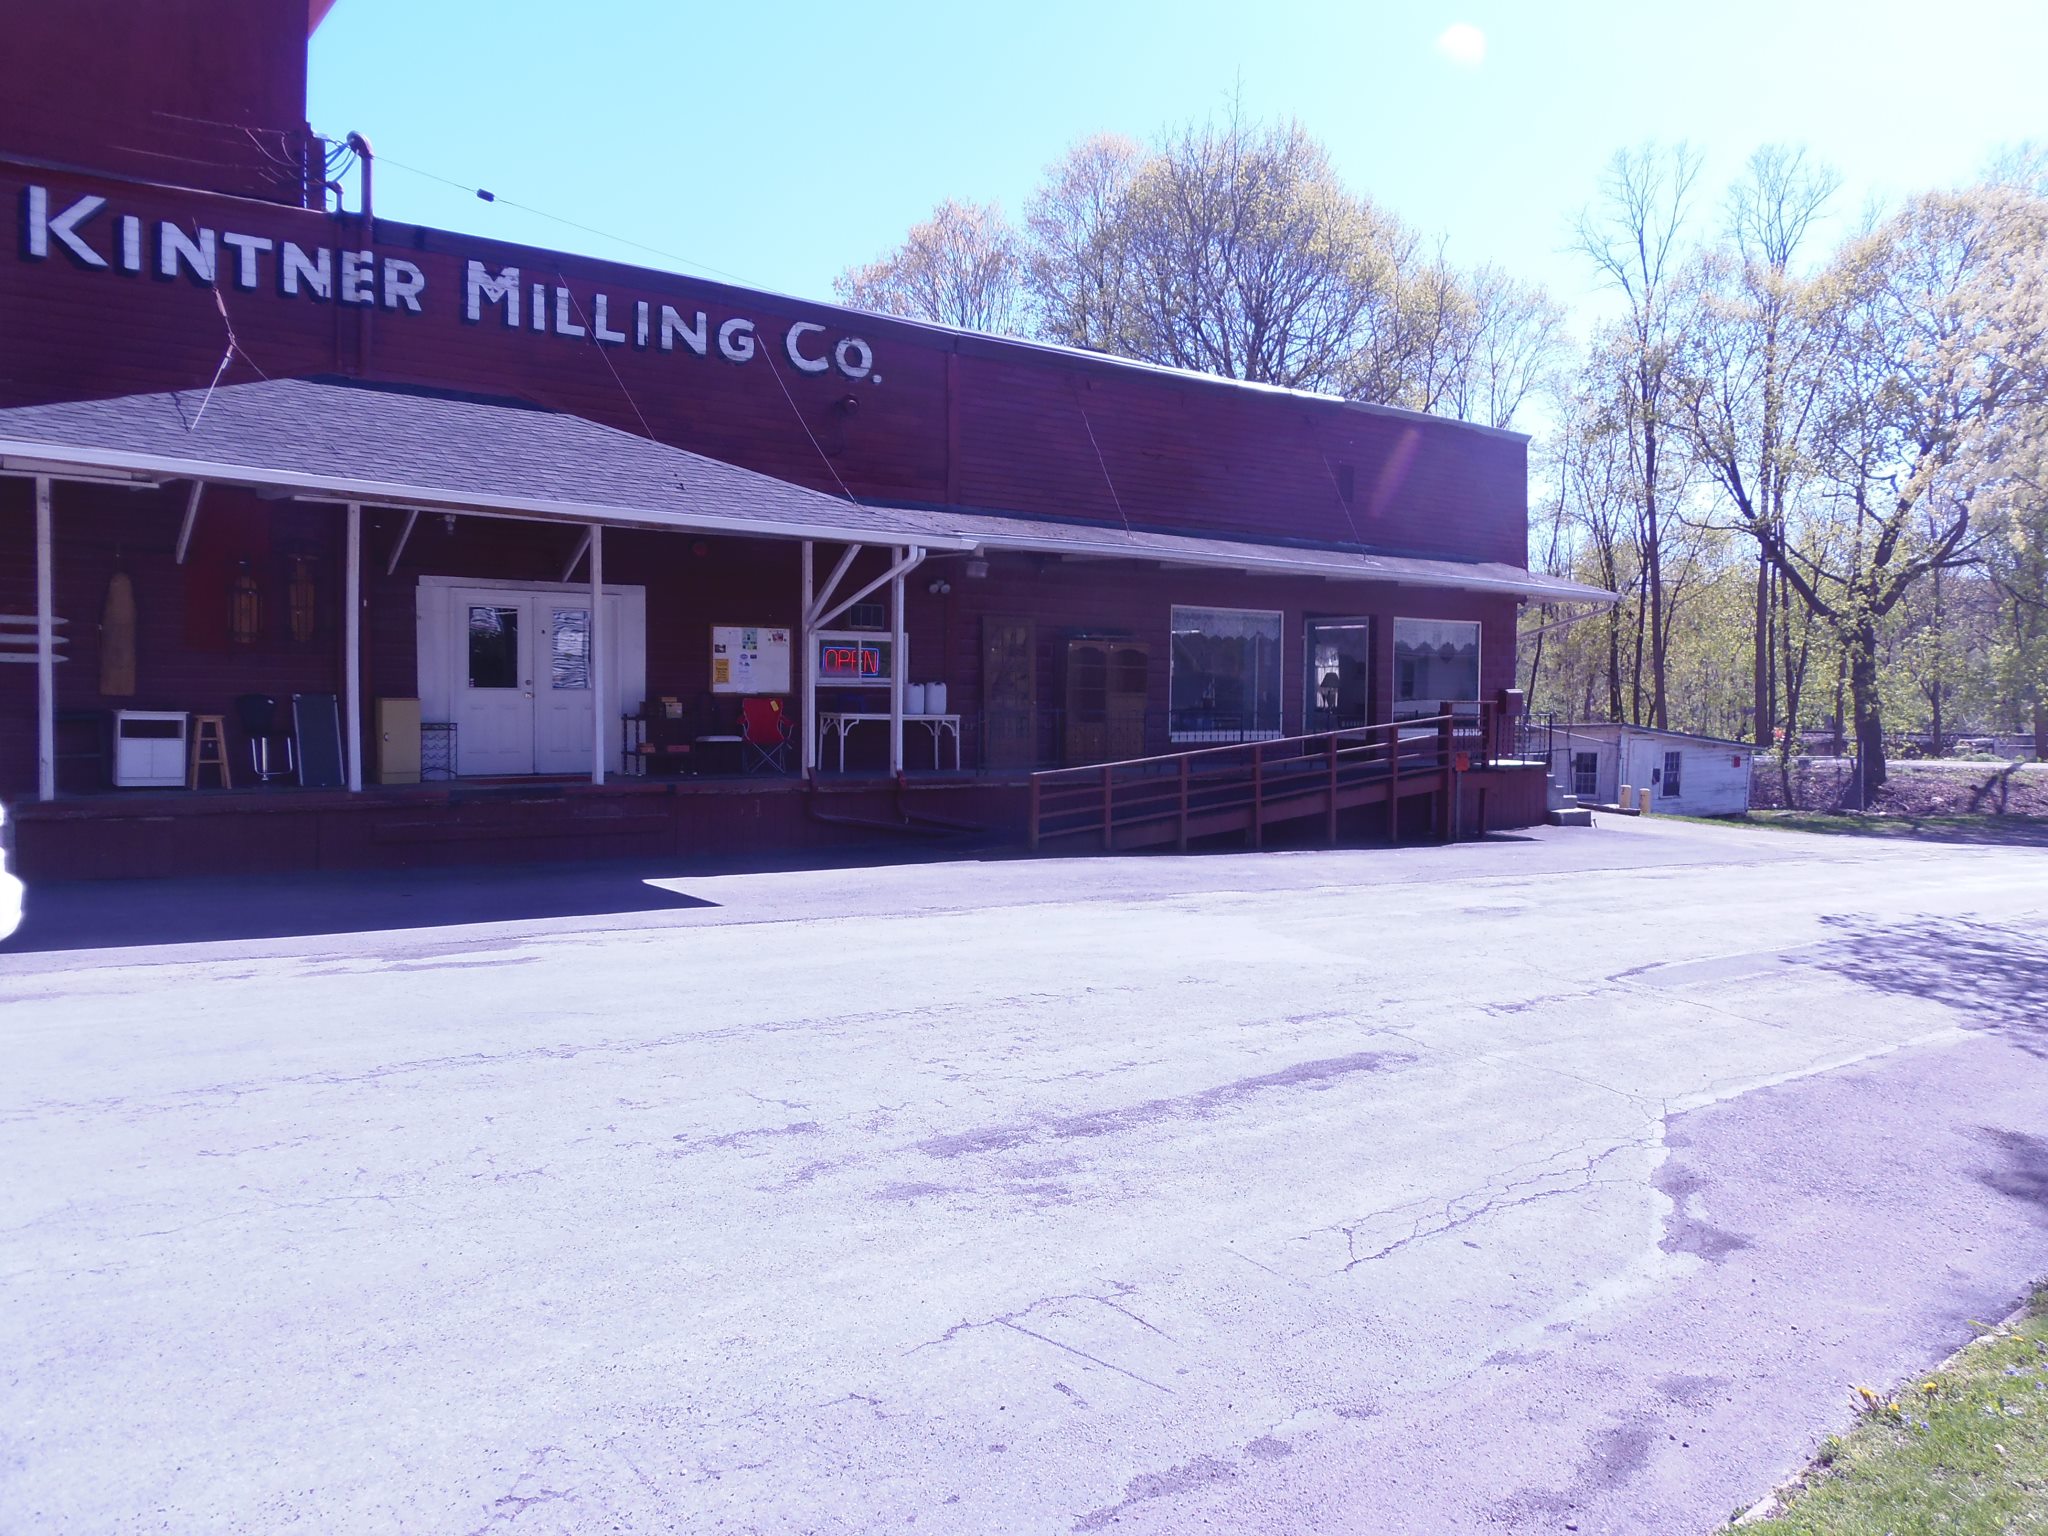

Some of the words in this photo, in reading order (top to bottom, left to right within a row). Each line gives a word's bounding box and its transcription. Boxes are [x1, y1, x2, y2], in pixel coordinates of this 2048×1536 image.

[26, 184, 427, 312] KINTNER
[466, 259, 757, 364] MILLING
[785, 321, 883, 386] CO.
[825, 649, 877, 673] OPEN
